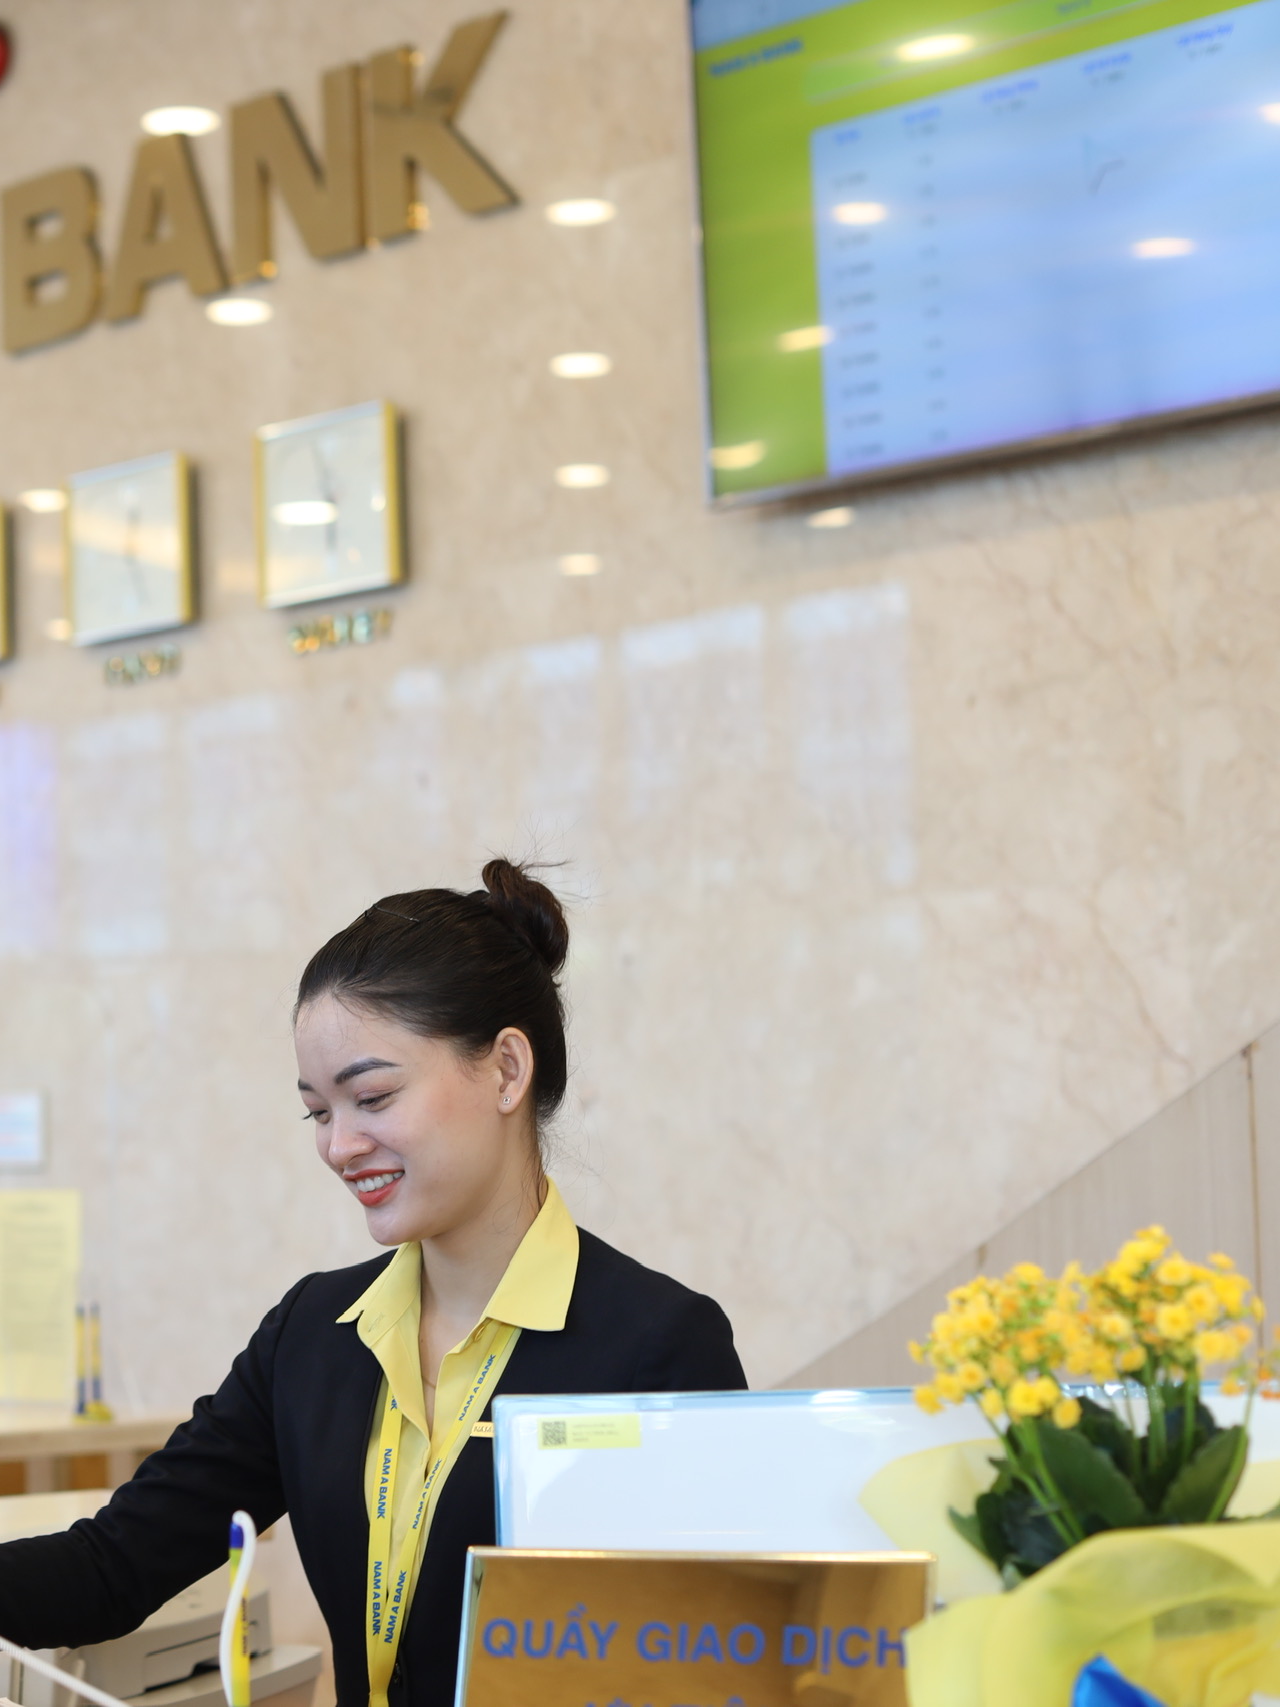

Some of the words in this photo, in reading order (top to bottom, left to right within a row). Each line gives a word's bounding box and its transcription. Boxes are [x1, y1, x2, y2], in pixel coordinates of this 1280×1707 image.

[0, 9, 522, 356] BANK
[458, 1394, 474, 1421] NAM
[477, 1354, 496, 1385] BANK
[382, 1448, 393, 1475] NAM
[380, 1476, 389, 1485] A
[412, 1501, 424, 1529] NAM
[424, 1458, 442, 1489] BANK
[377, 1486, 388, 1519] BANK
[373, 1561, 382, 1589] NAM
[393, 1570, 407, 1603] BANK
[372, 1591, 381, 1600] A
[391, 1606, 399, 1614] A
[372, 1602, 381, 1636] BANK
[384, 1615, 397, 1643] NAM
[481, 1602, 619, 1660] QUẦY
[635, 1621, 766, 1666] GIAO
[781, 1624, 907, 1675] DỊCH
